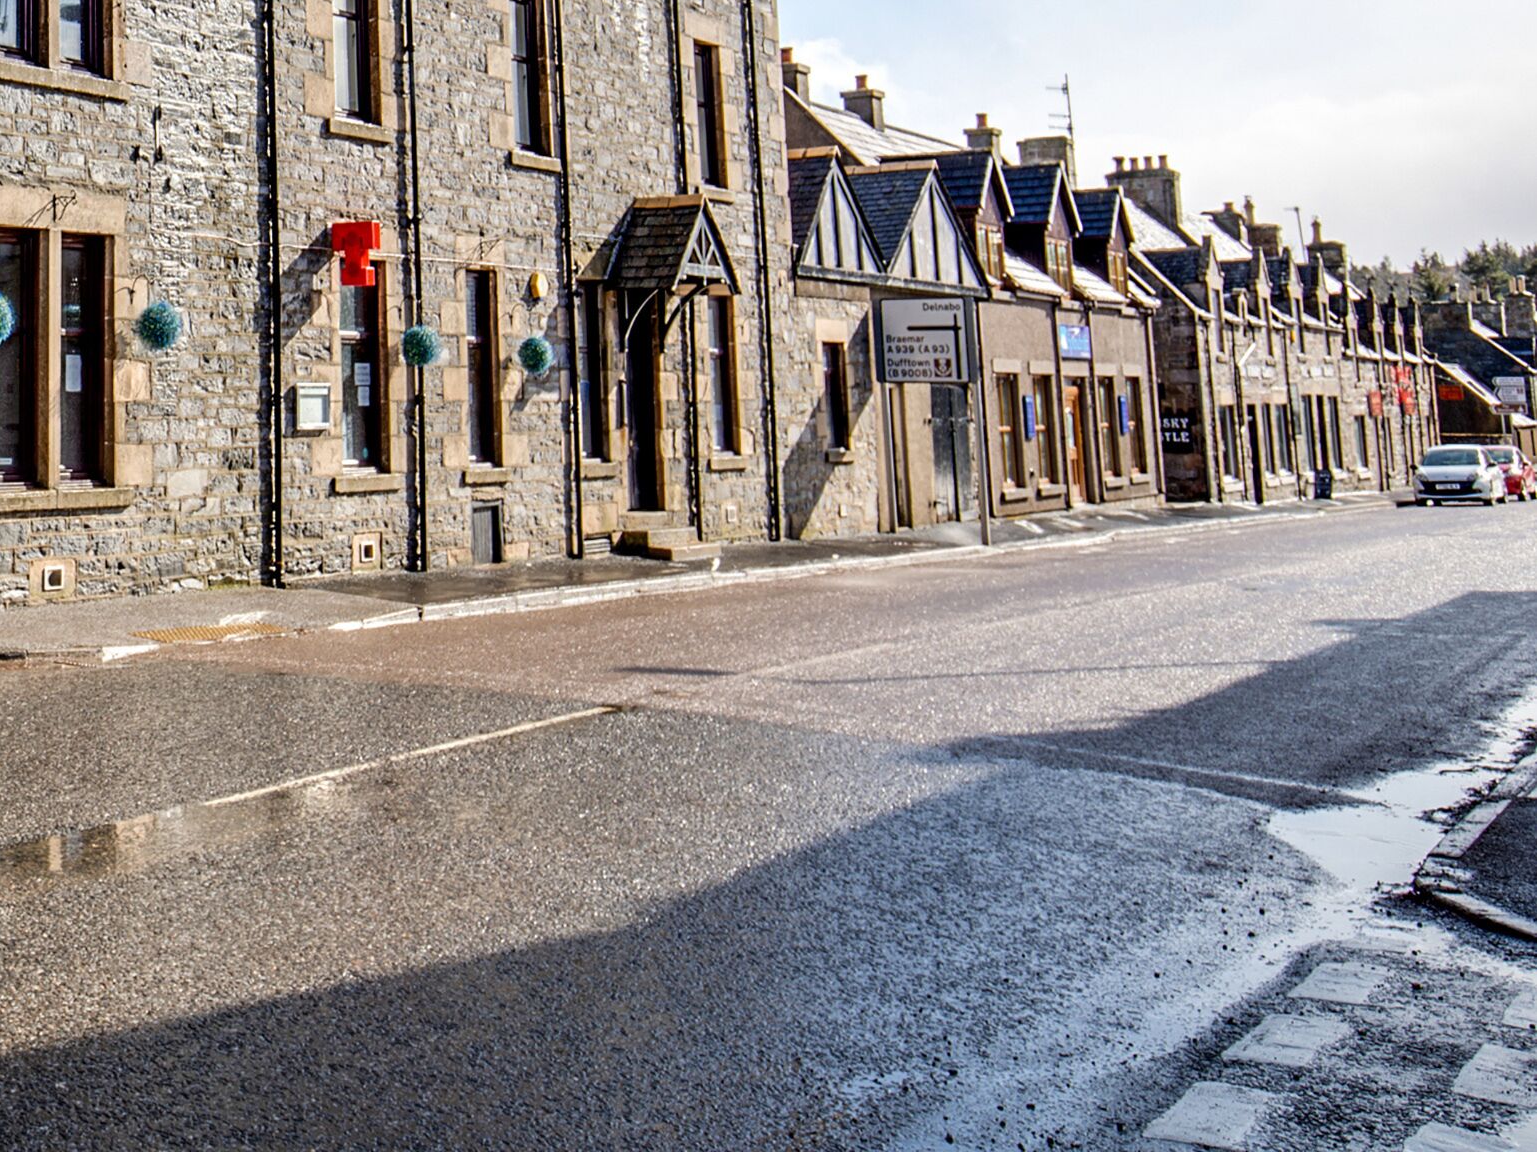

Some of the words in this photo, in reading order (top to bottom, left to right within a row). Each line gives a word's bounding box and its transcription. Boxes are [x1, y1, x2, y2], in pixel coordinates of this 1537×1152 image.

[922, 303, 961, 311] Delnabo
[886, 334, 924, 343] Braemar
[887, 358, 930, 367] Dufftown
